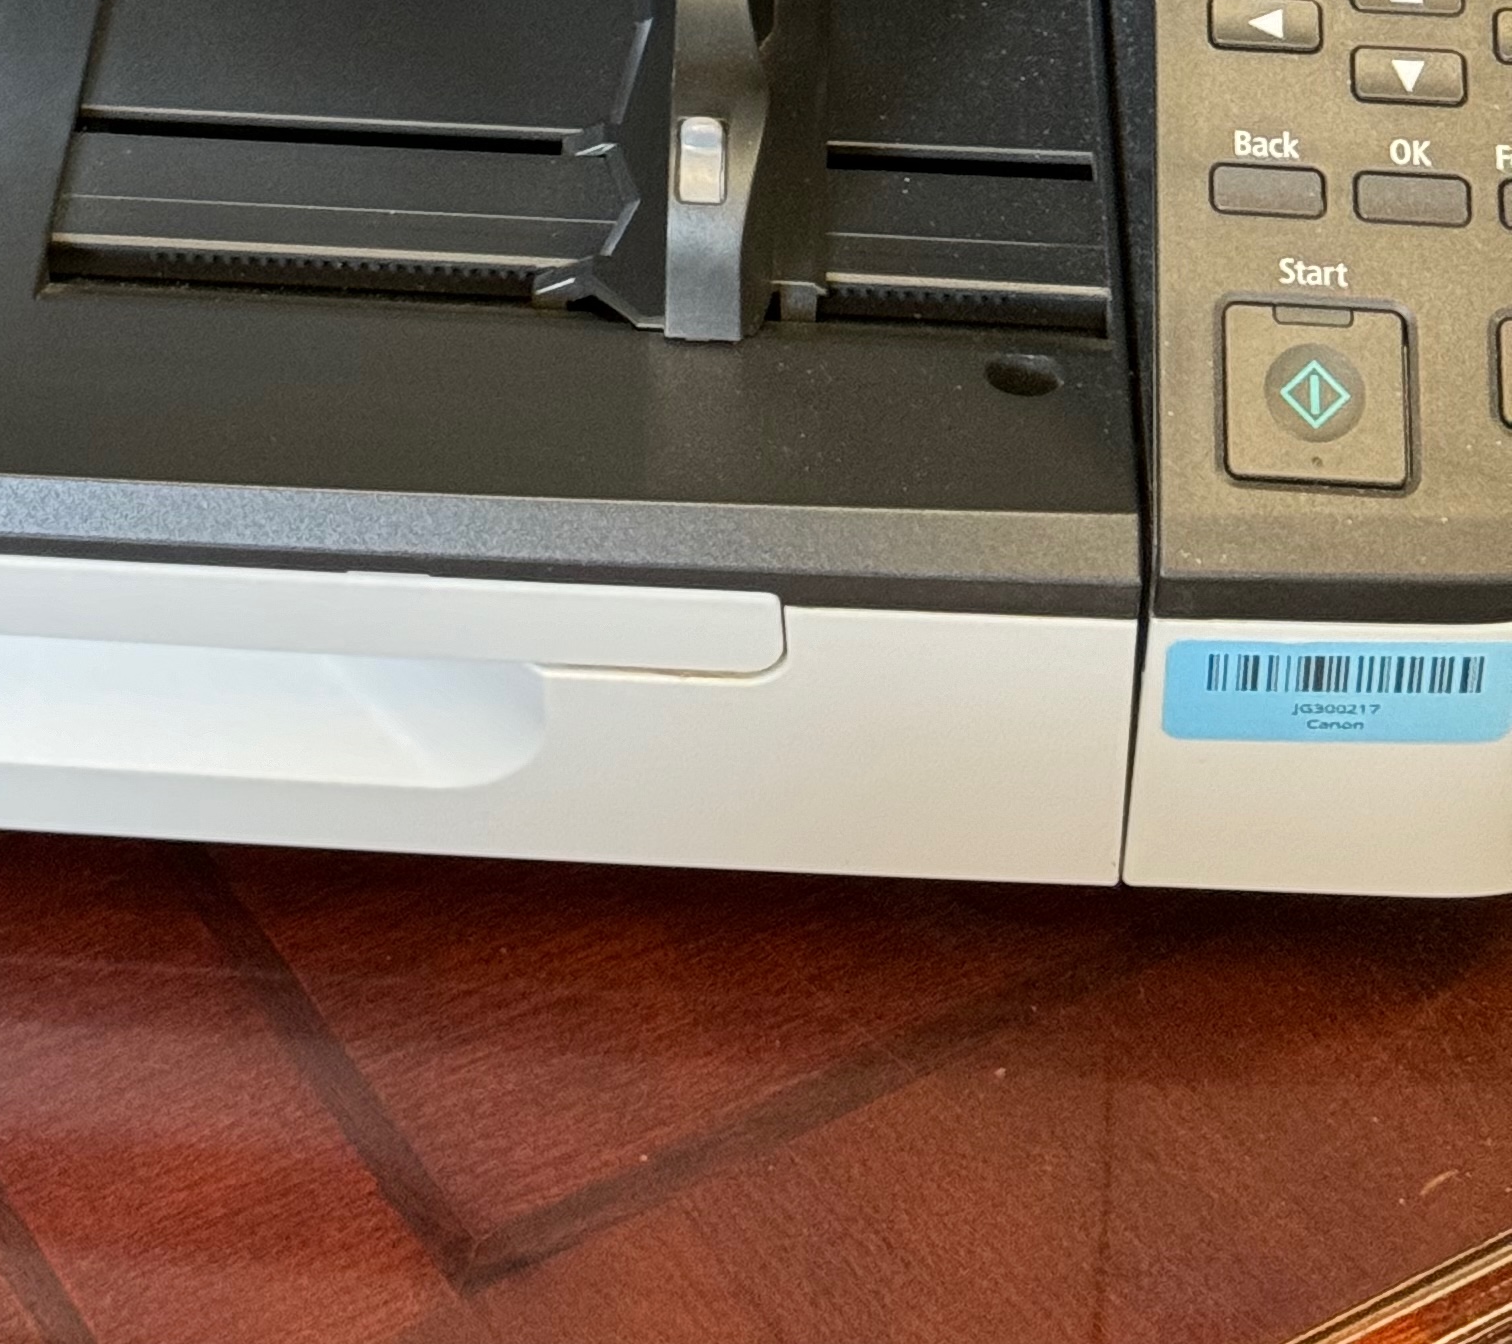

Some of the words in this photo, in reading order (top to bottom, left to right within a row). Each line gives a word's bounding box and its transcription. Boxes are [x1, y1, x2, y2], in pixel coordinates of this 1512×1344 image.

[1234, 130, 1300, 159] Back
[1389, 138, 1432, 167] OK
[1278, 257, 1349, 288] Start
[1306, 719, 1365, 730] Canon
